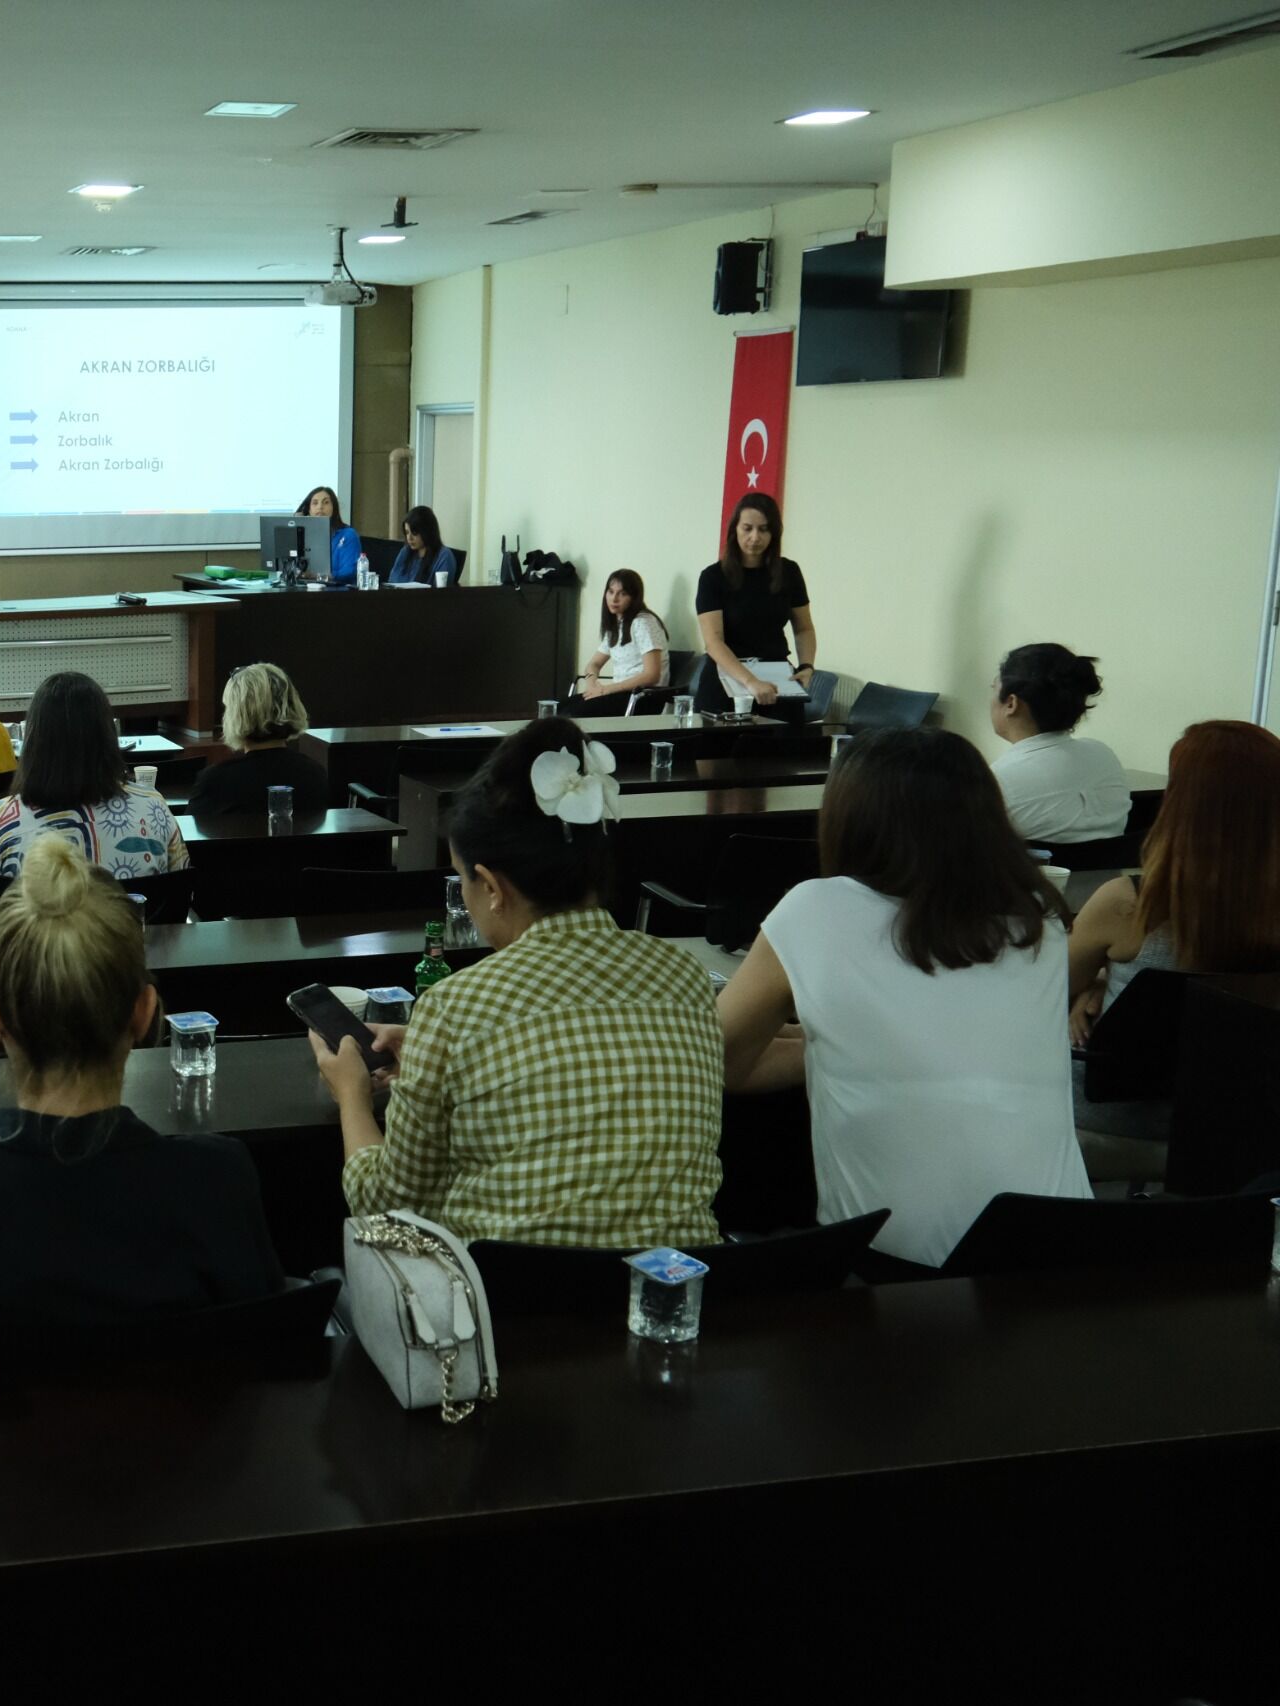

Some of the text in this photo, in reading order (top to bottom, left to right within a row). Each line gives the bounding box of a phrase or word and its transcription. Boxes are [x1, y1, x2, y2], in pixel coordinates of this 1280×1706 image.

[80, 356, 215, 373] AKRAN ZORBALIĞI
[58, 410, 99, 423] Akran
[58, 434, 112, 447] Zorbalık
[58, 457, 163, 472] Akran Zorbalığı
